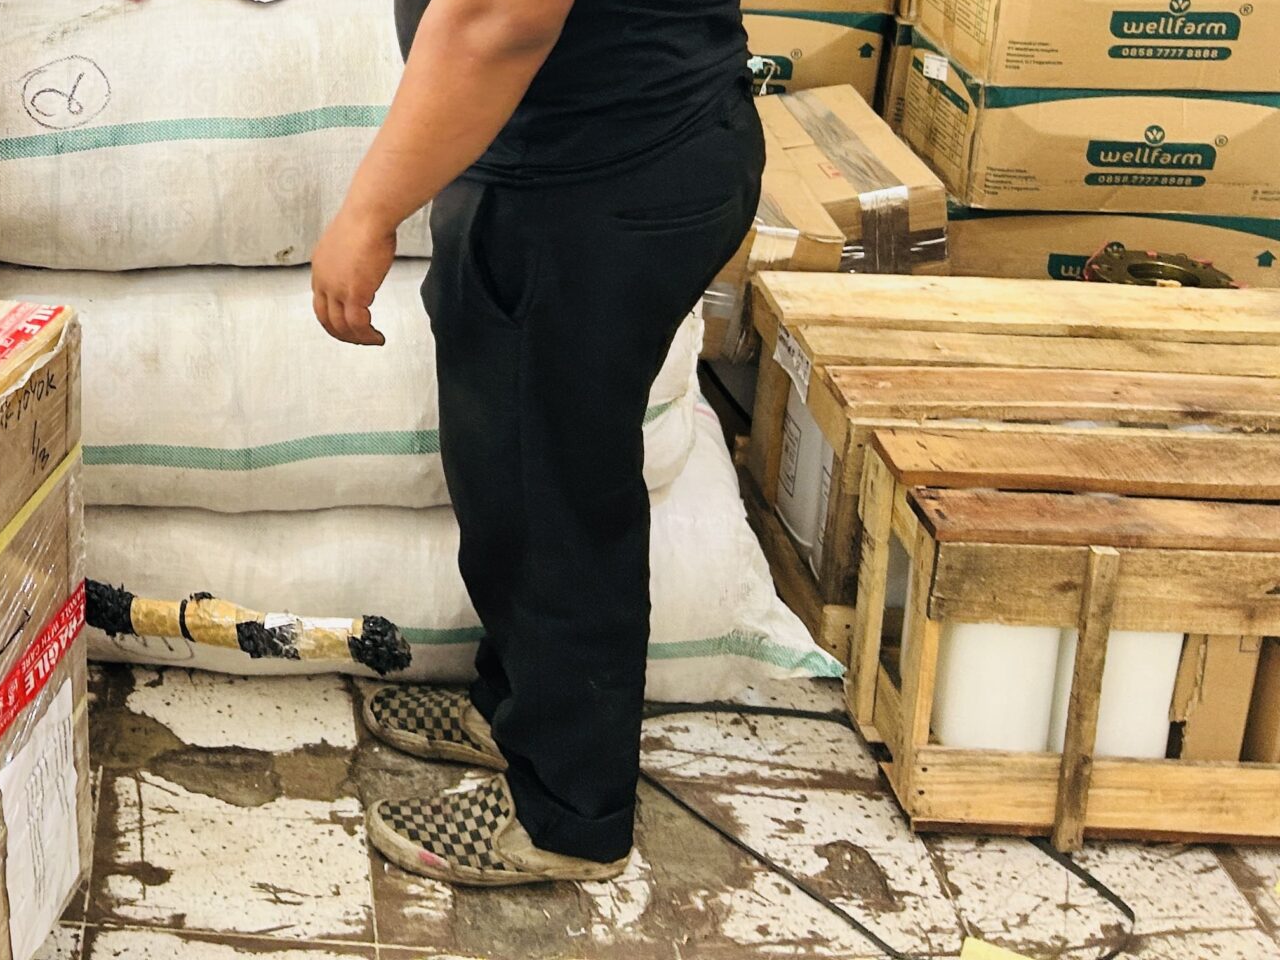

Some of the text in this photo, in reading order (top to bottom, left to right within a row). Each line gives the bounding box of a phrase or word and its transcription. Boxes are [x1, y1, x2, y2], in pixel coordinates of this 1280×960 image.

[1122, 16, 1228, 37] wellfarm
[1121, 47, 1219, 58] 0858 7777 8888
[1099, 145, 1203, 166] wellfarm
[24, 602, 85, 696] FRAGILE
